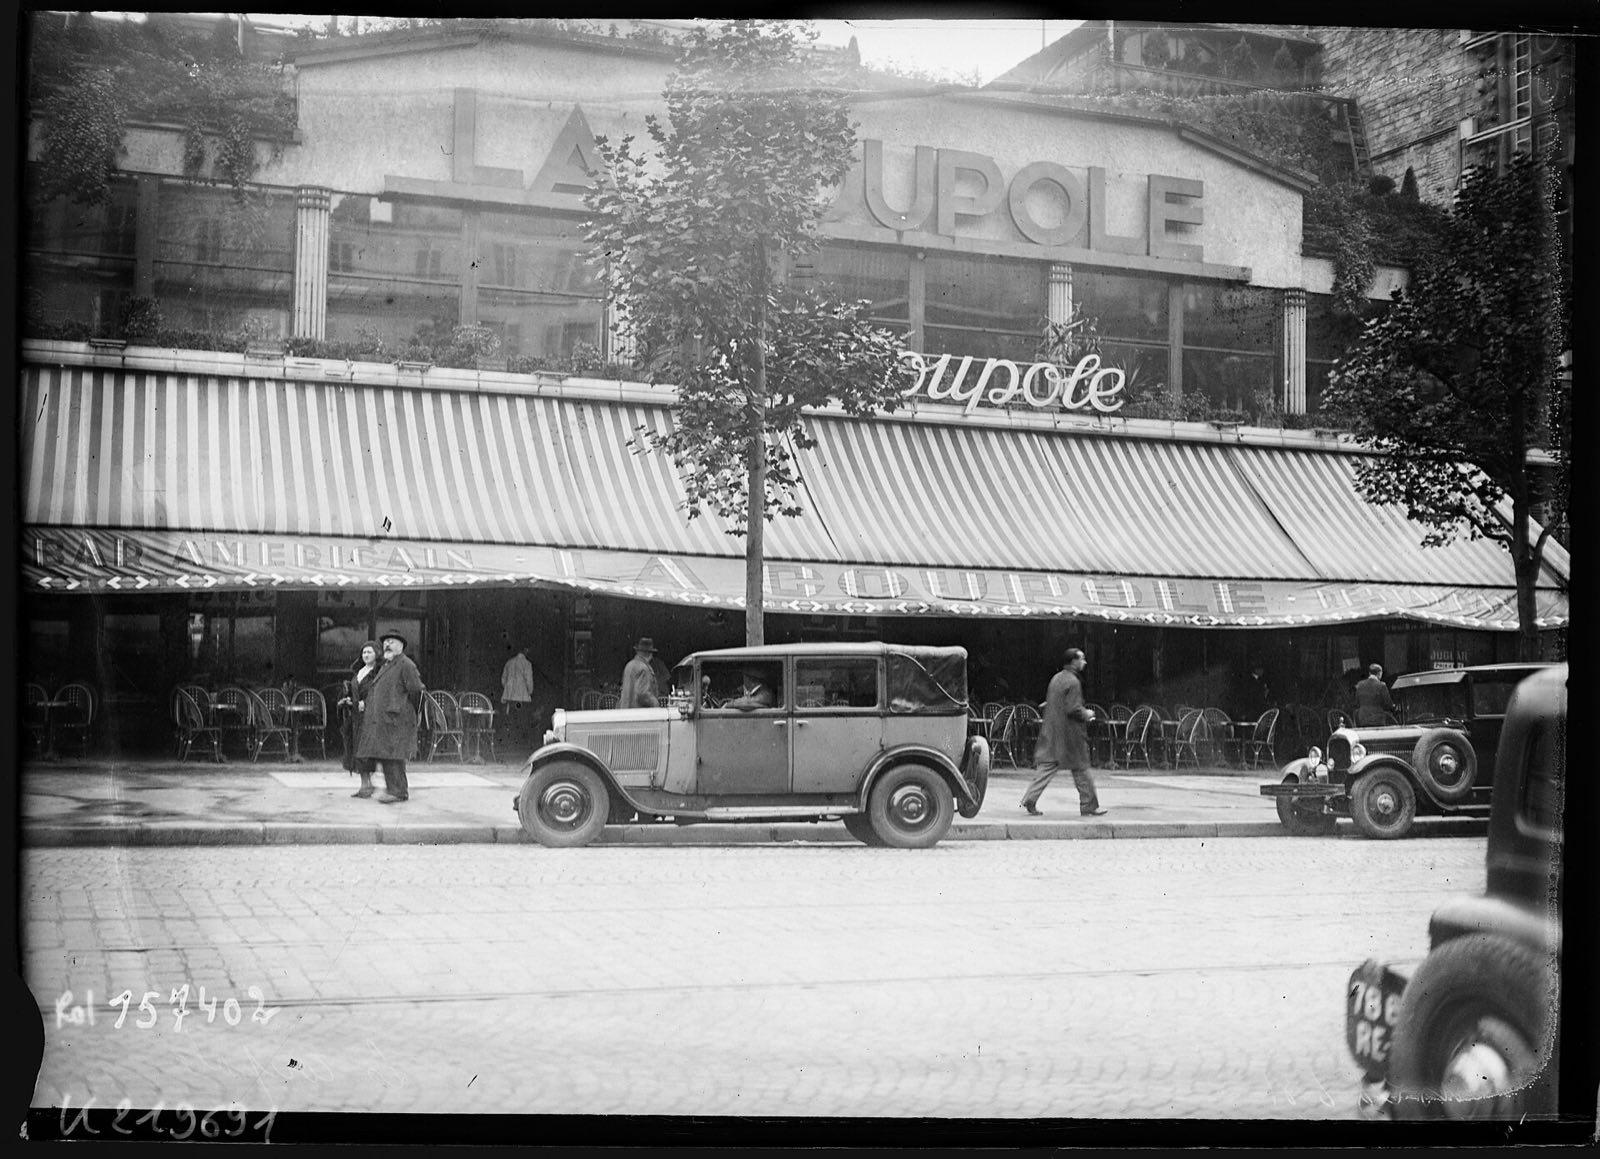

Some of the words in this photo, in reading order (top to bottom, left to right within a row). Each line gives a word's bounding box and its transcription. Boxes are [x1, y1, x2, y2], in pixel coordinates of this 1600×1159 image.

[453, 87, 607, 196] LA
[814, 138, 1204, 263] UPOLE
[900, 351, 1126, 416] oupole
[33, 537, 144, 568] BAR
[173, 539, 474, 570] AMERICAIN
[763, 562, 1269, 615] COUPOLE
